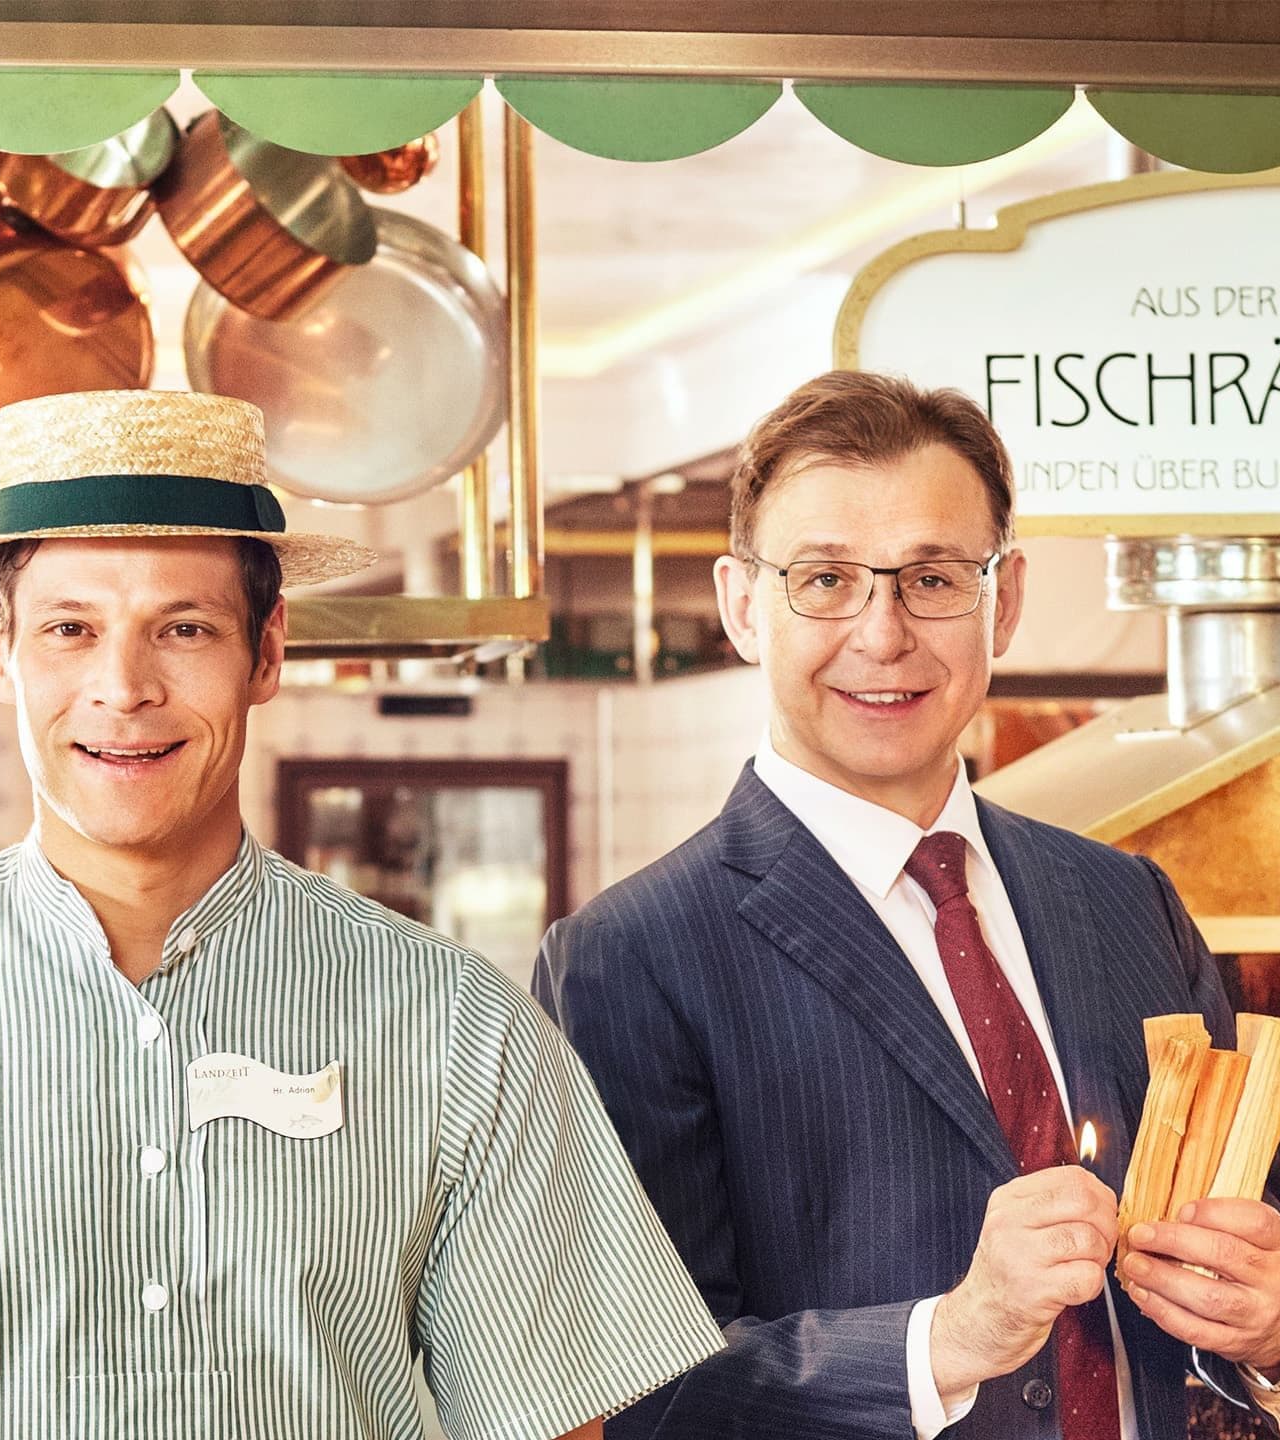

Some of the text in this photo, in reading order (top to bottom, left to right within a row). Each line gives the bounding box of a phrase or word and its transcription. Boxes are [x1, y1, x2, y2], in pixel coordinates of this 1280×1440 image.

[1130, 285, 1201, 318] AUS
[1213, 285, 1279, 318] DER
[1133, 453, 1221, 491] ÜBER
